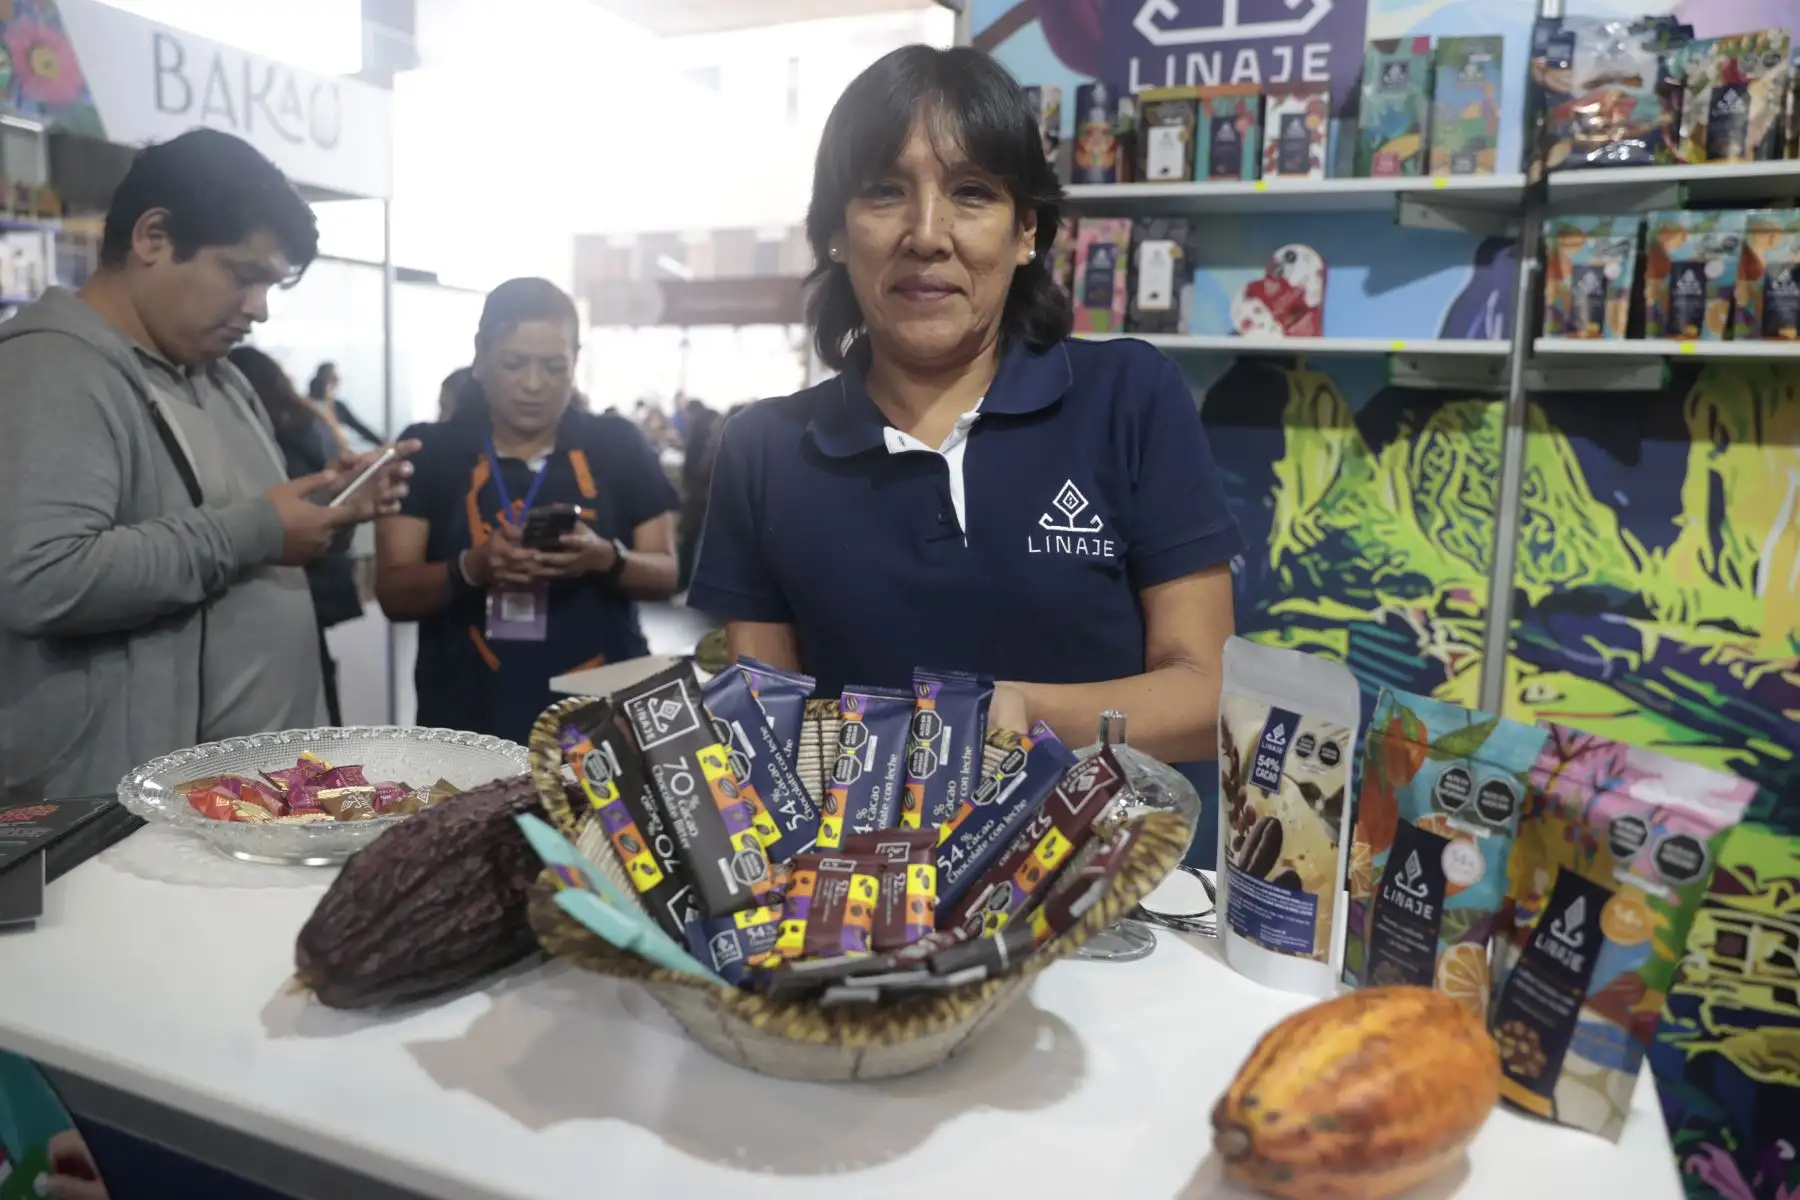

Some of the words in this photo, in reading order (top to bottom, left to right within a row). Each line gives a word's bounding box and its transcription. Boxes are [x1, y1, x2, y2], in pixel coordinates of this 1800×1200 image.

[1129, 43, 1332, 95] LINAJE
[152, 31, 343, 150] BAKAO
[1028, 535, 1115, 557] LINAJE
[775, 752, 788, 771] con
[883, 781, 894, 799] con
[960, 776, 971, 797] con
[878, 803, 890, 830] olate
[1383, 885, 1435, 920] LINAJE
